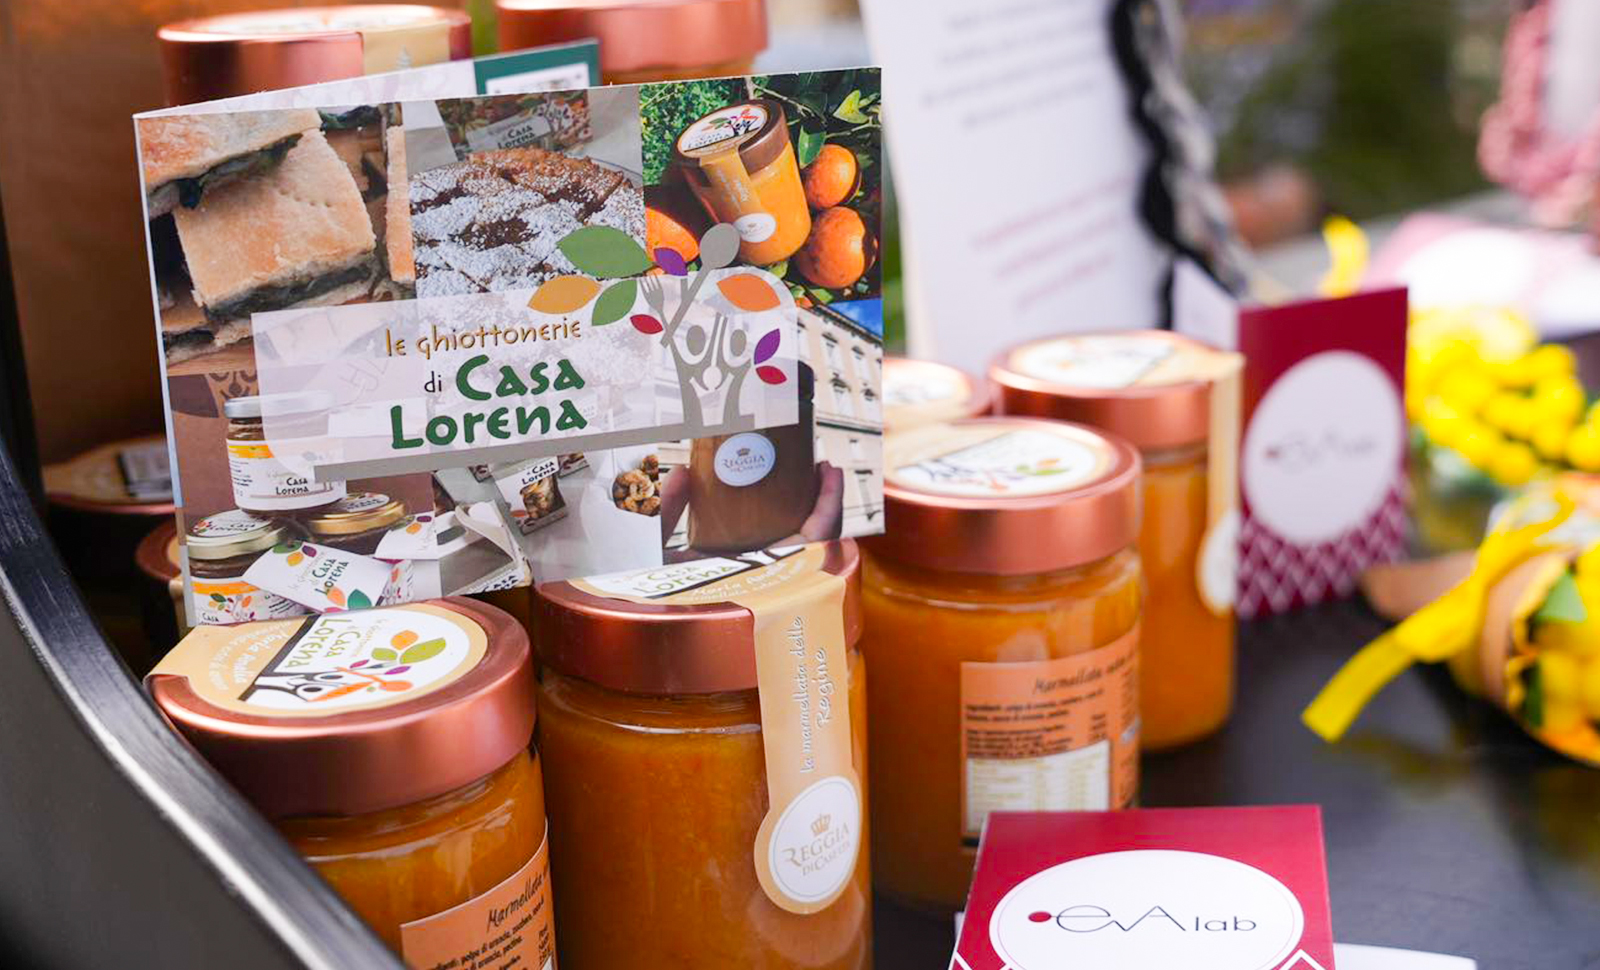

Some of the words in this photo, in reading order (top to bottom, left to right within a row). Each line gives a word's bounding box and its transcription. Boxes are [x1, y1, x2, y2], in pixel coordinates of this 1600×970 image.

[386, 328, 406, 357] le
[416, 316, 581, 360] ghiottonerie
[424, 371, 442, 393] di
[456, 354, 586, 401] Casa
[390, 399, 588, 449] Lorena
[816, 647, 836, 728] Regine
[1194, 916, 1257, 932] lab
